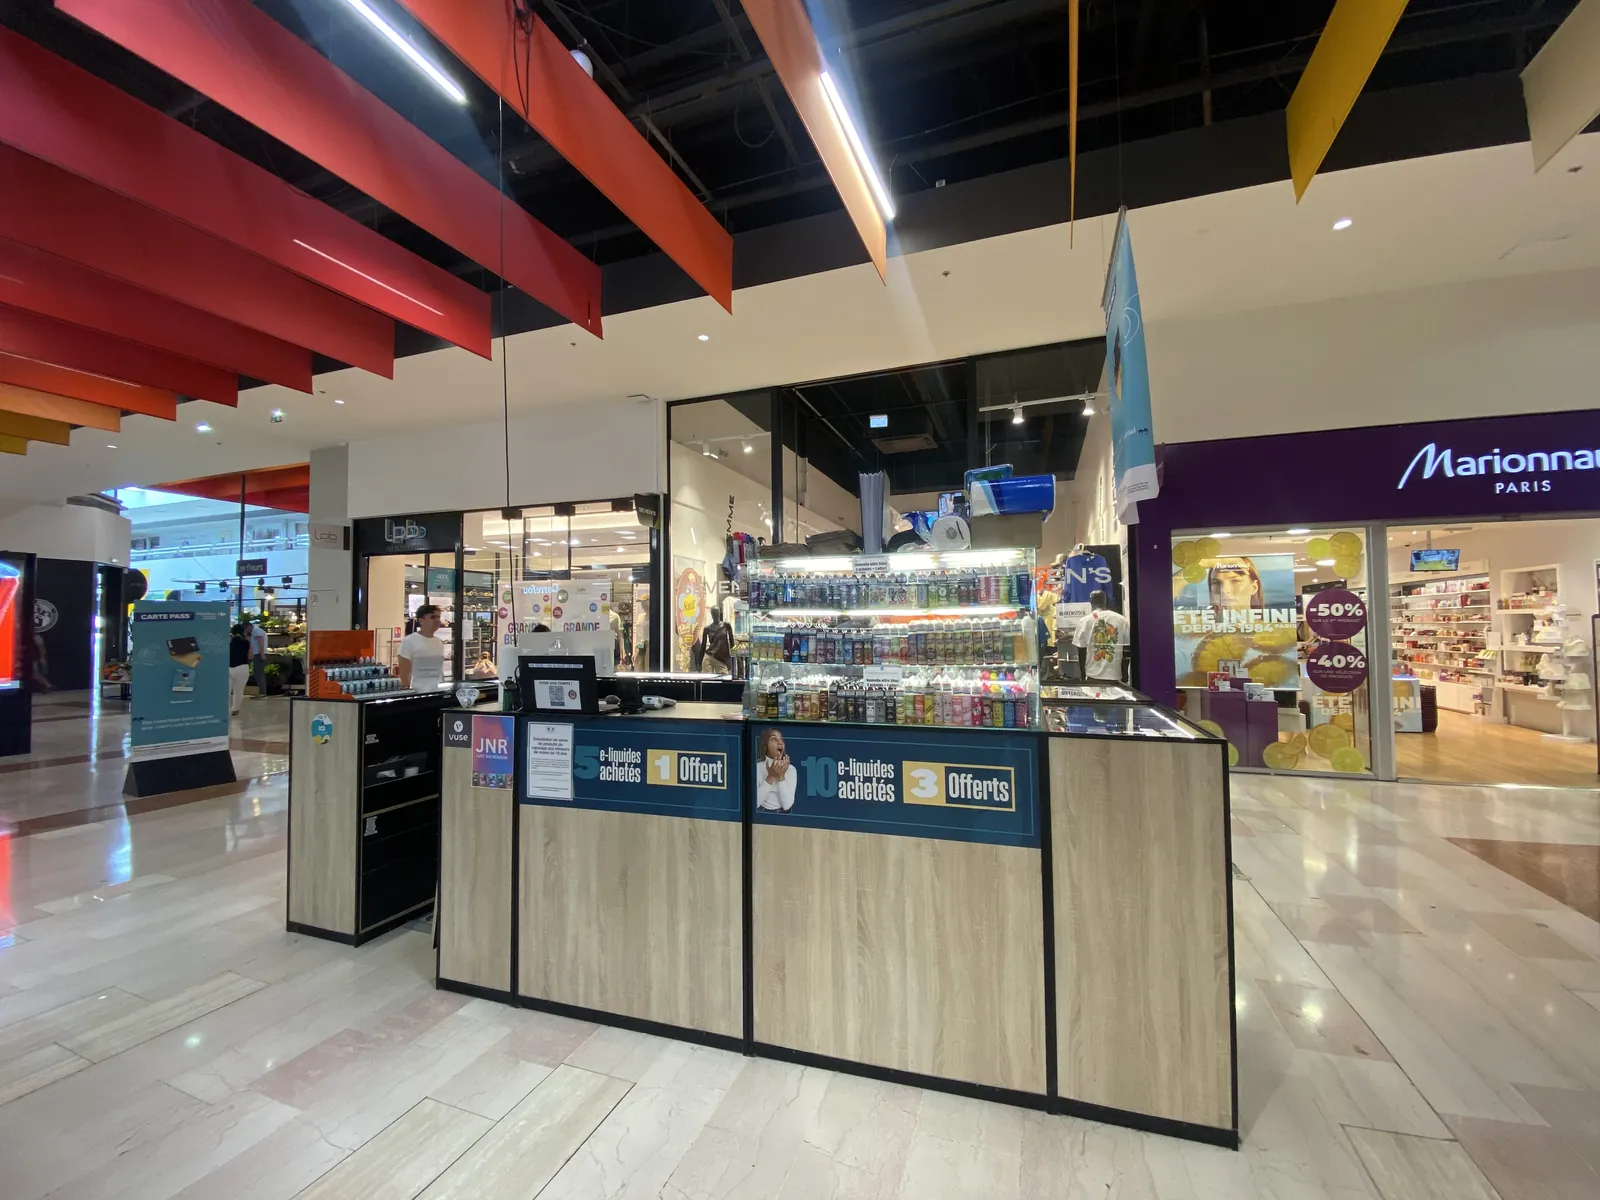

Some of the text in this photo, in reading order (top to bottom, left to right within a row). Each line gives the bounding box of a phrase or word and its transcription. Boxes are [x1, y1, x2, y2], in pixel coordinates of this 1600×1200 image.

[1495, 480, 1552, 494] PARIS
[1310, 603, 1363, 617] -50%
[563, 622, 600, 632] GRANDE
[1240, 624, 1273, 633] 1984
[1310, 654, 1366, 669] -40%
[476, 738, 508, 755] JNR
[600, 747, 641, 764] e-liquides
[574, 746, 599, 779] 5
[654, 755, 724, 784] 1 Offert
[838, 758, 894, 780] e-liquides
[600, 762, 641, 783] achetés
[801, 756, 838, 798] 10
[838, 777, 895, 803] achetés
[910, 768, 1010, 802] 3 Offerts
